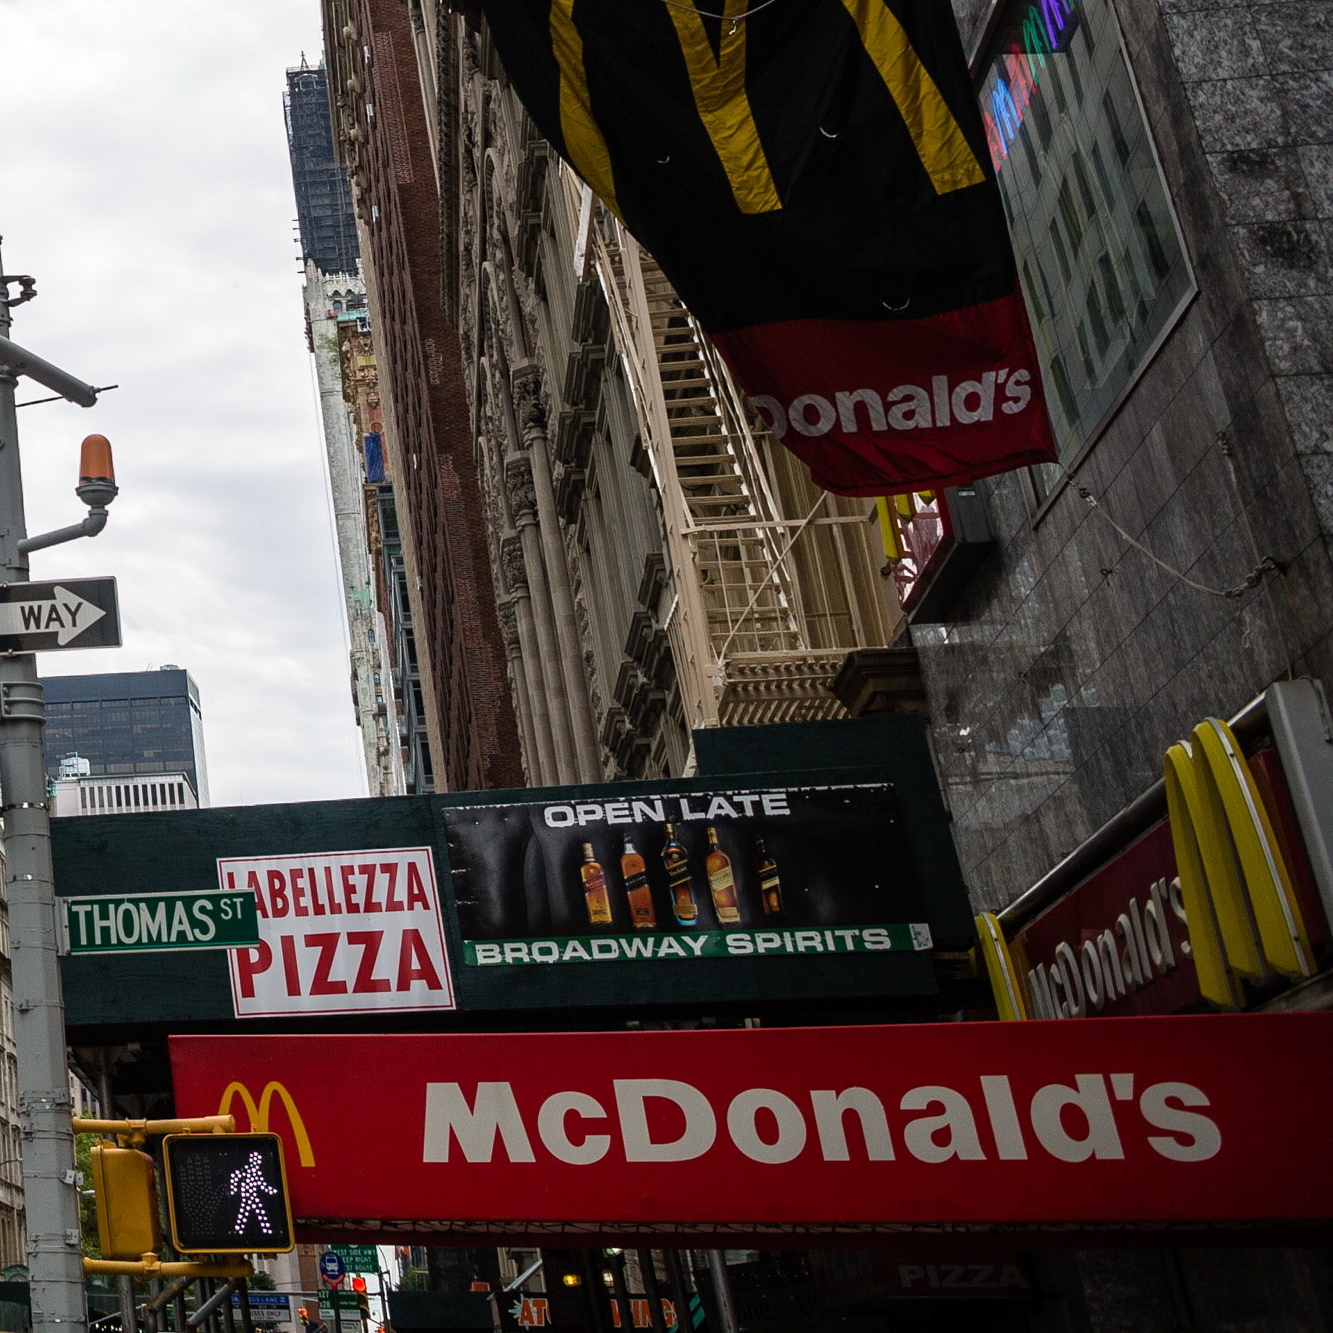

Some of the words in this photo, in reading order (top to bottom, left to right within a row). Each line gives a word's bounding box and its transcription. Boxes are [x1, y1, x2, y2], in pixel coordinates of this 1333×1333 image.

[749, 367, 1032, 441] Donald's
[19, 602, 84, 631] WAY
[543, 798, 665, 828] OPEN
[680, 792, 792, 822] LATE
[71, 898, 217, 946] THOMAS
[220, 897, 245, 921] ST
[236, 928, 443, 999] PIZZA
[476, 934, 709, 966] BROADWAY
[725, 928, 892, 954] SPIRITS
[423, 1074, 1222, 1166] McDonald's
[897, 1264, 1032, 1288] PIZZA
